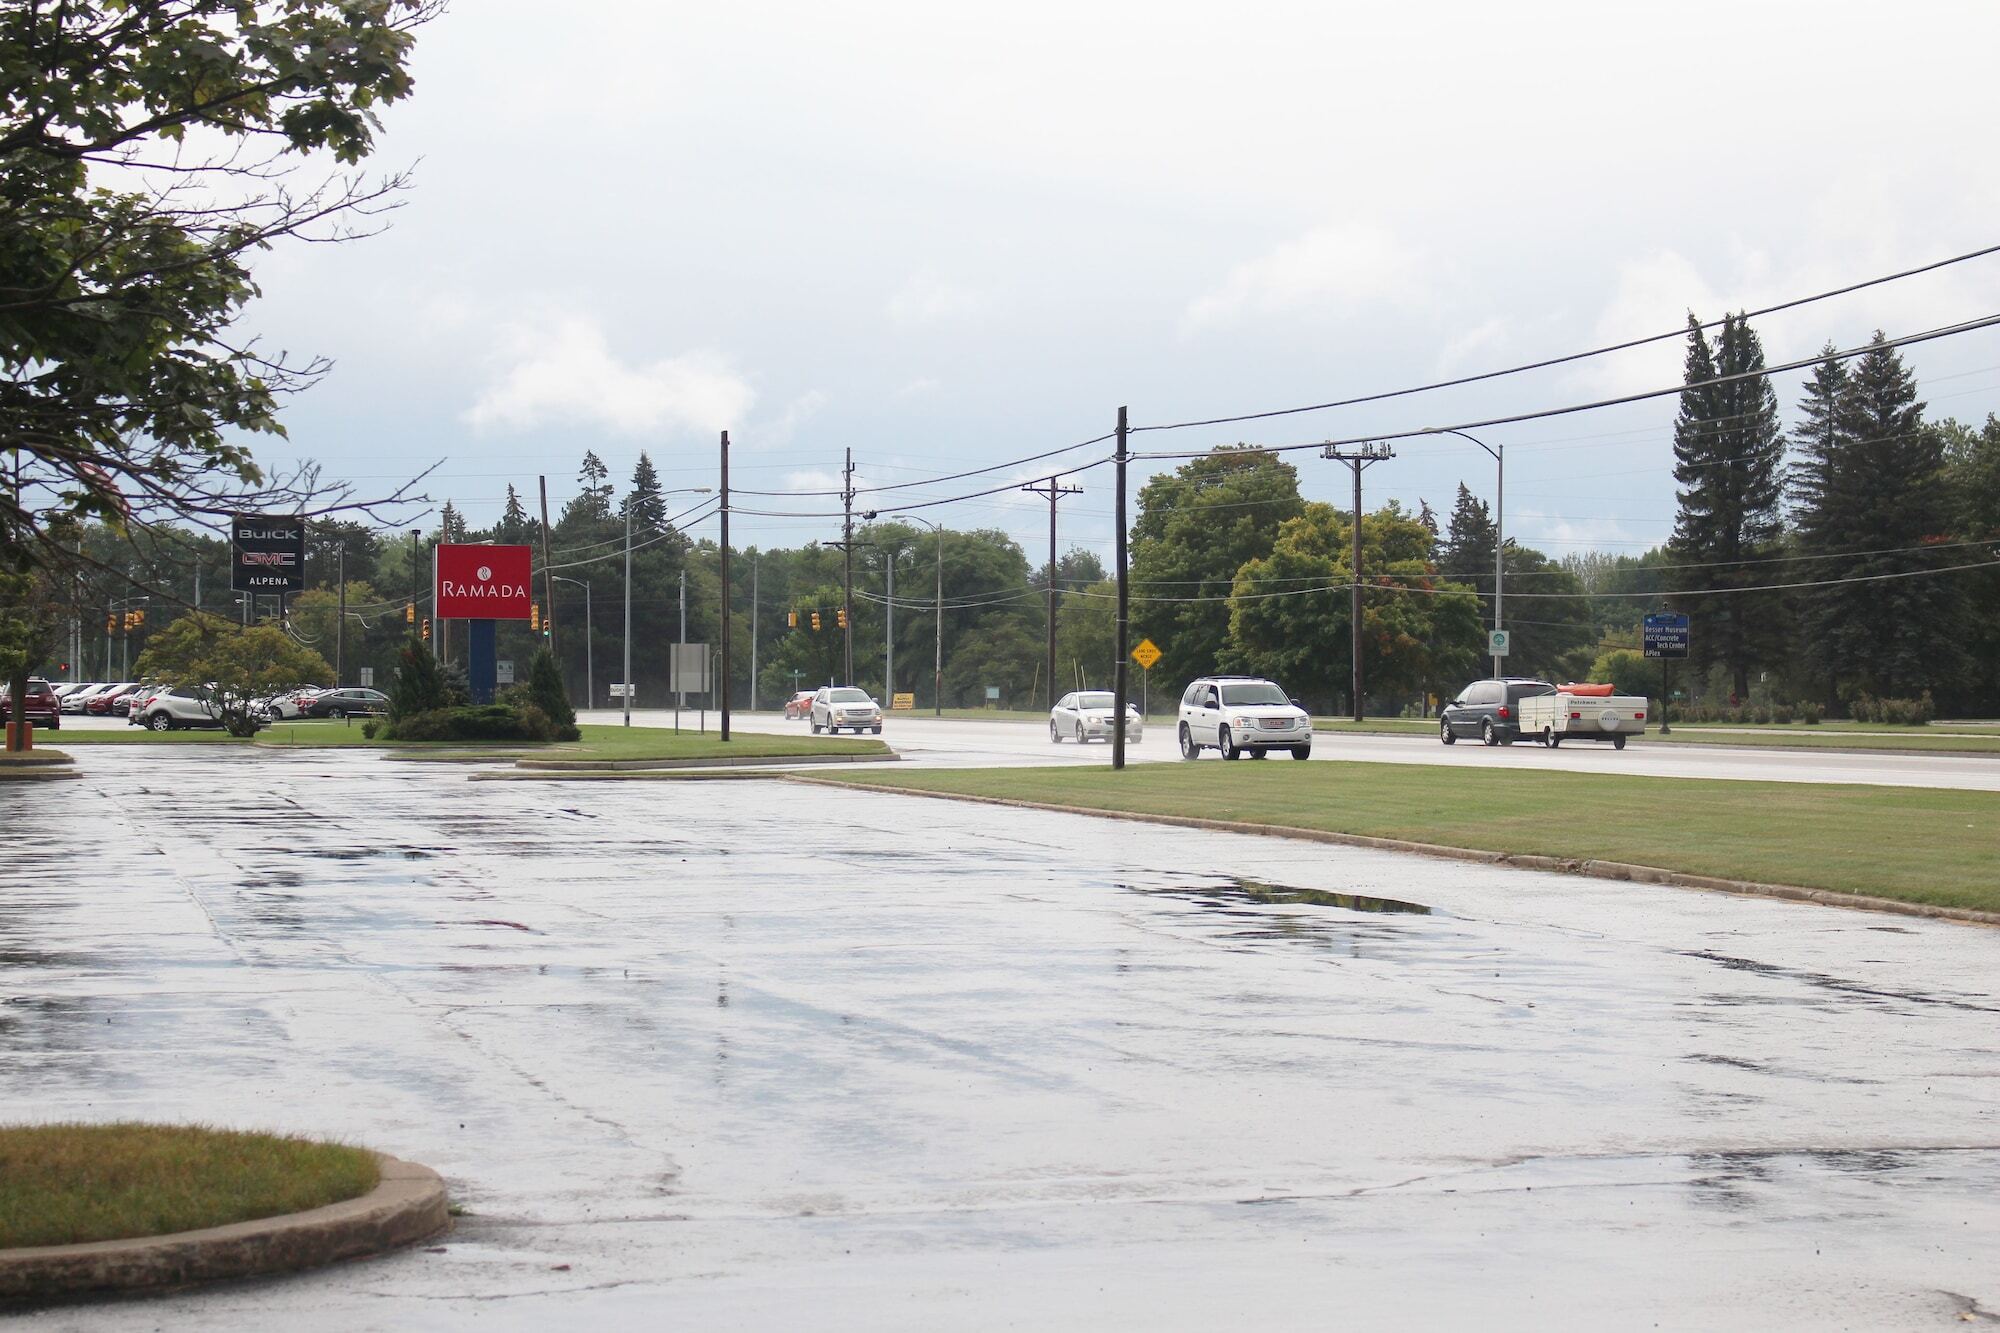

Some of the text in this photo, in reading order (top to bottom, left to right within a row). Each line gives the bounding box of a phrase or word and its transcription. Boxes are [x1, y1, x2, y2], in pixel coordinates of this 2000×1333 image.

[239, 529, 298, 539] BUICK
[243, 552, 296, 566] GMC
[249, 577, 289, 585] ALPENA
[442, 580, 526, 598] RAMADA
